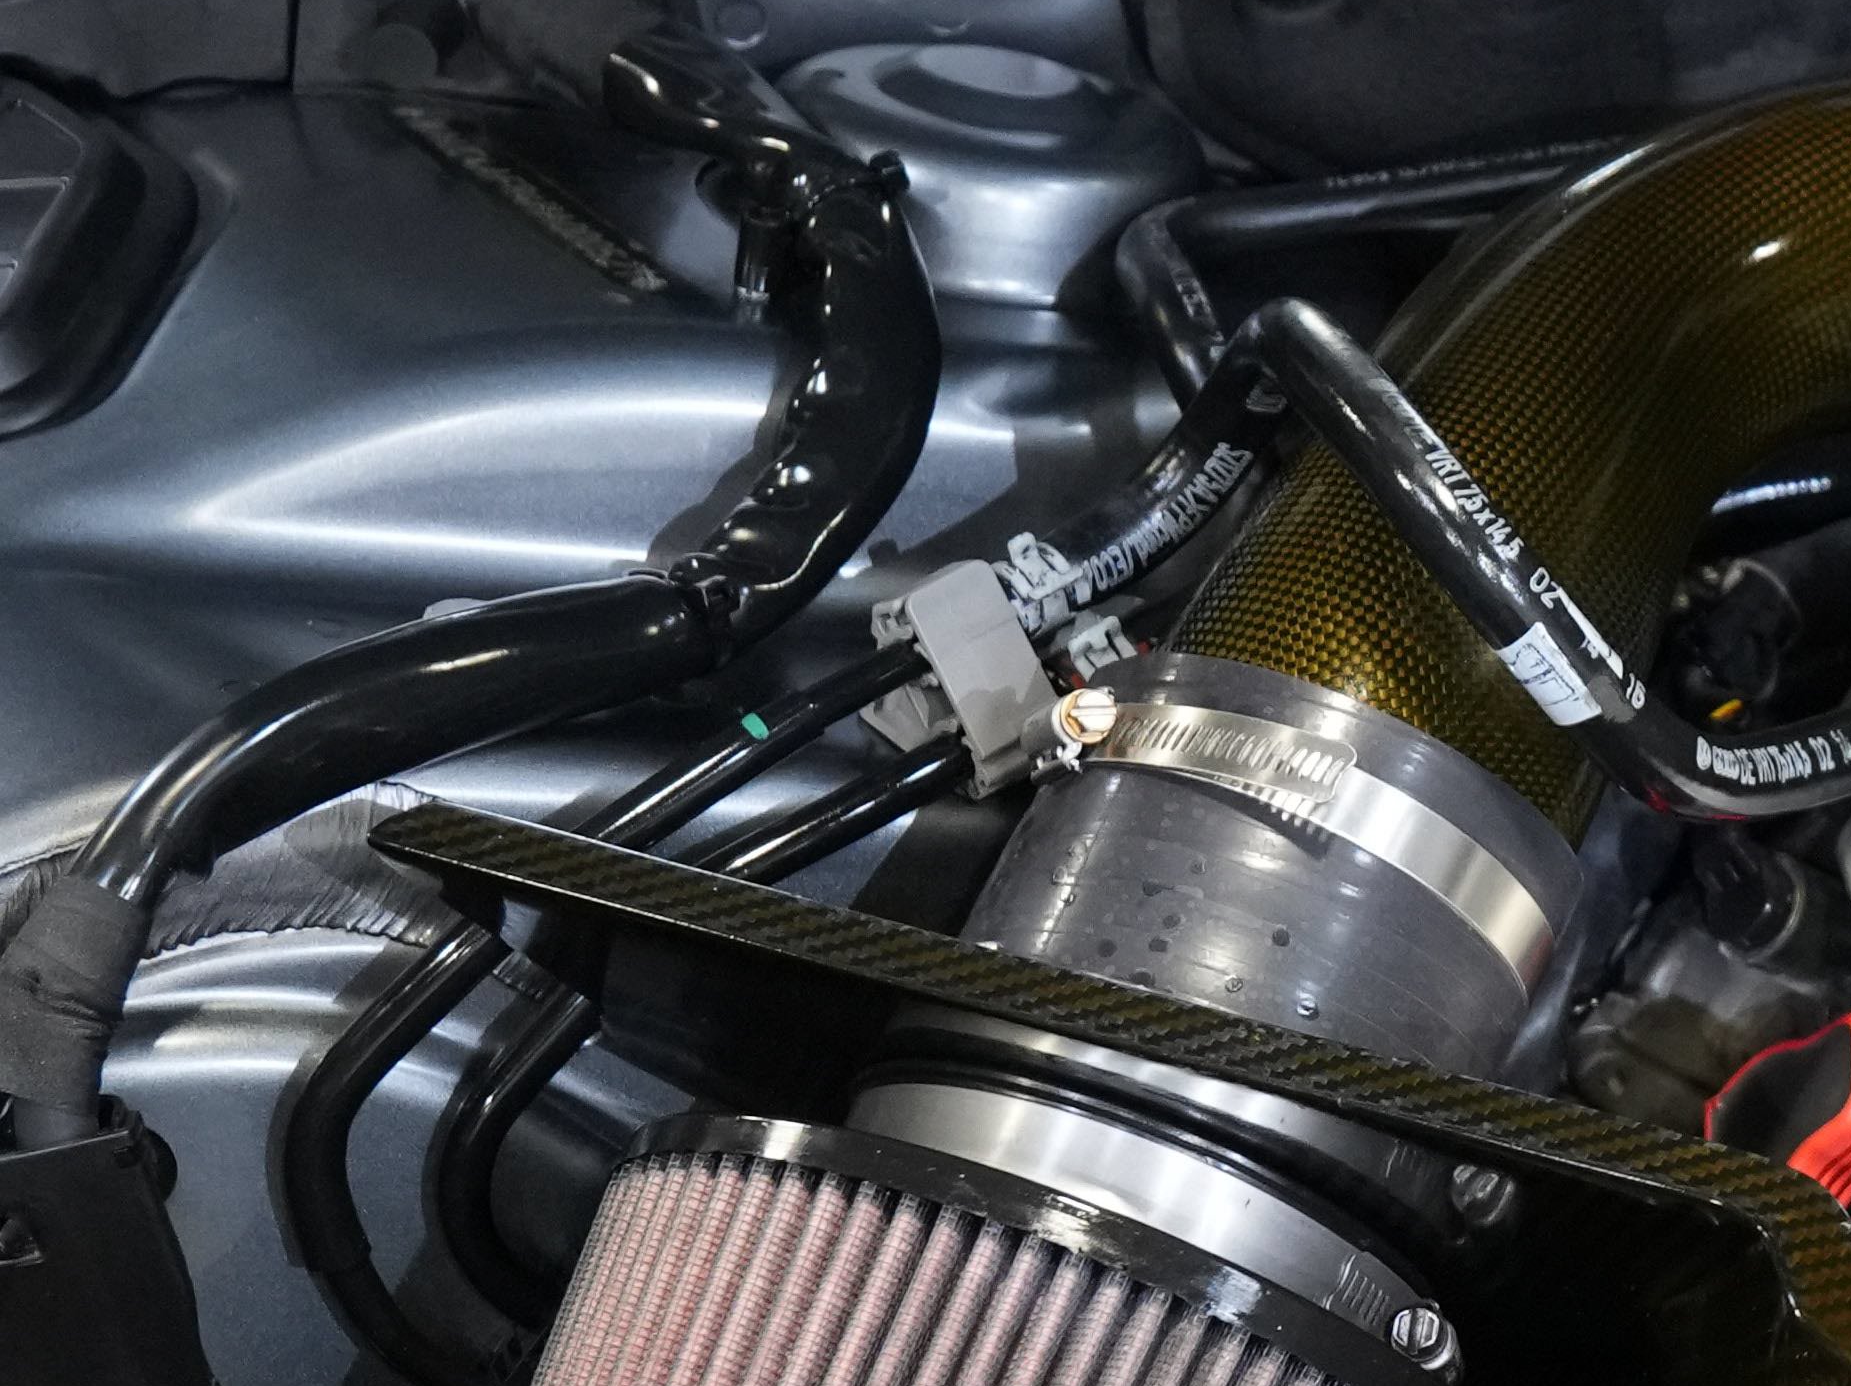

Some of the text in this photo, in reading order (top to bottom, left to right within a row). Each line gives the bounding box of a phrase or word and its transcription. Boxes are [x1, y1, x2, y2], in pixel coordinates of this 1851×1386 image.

[1425, 447, 1471, 486] VRT
[1530, 567, 1561, 609] 02
[1624, 671, 1646, 709] 16
